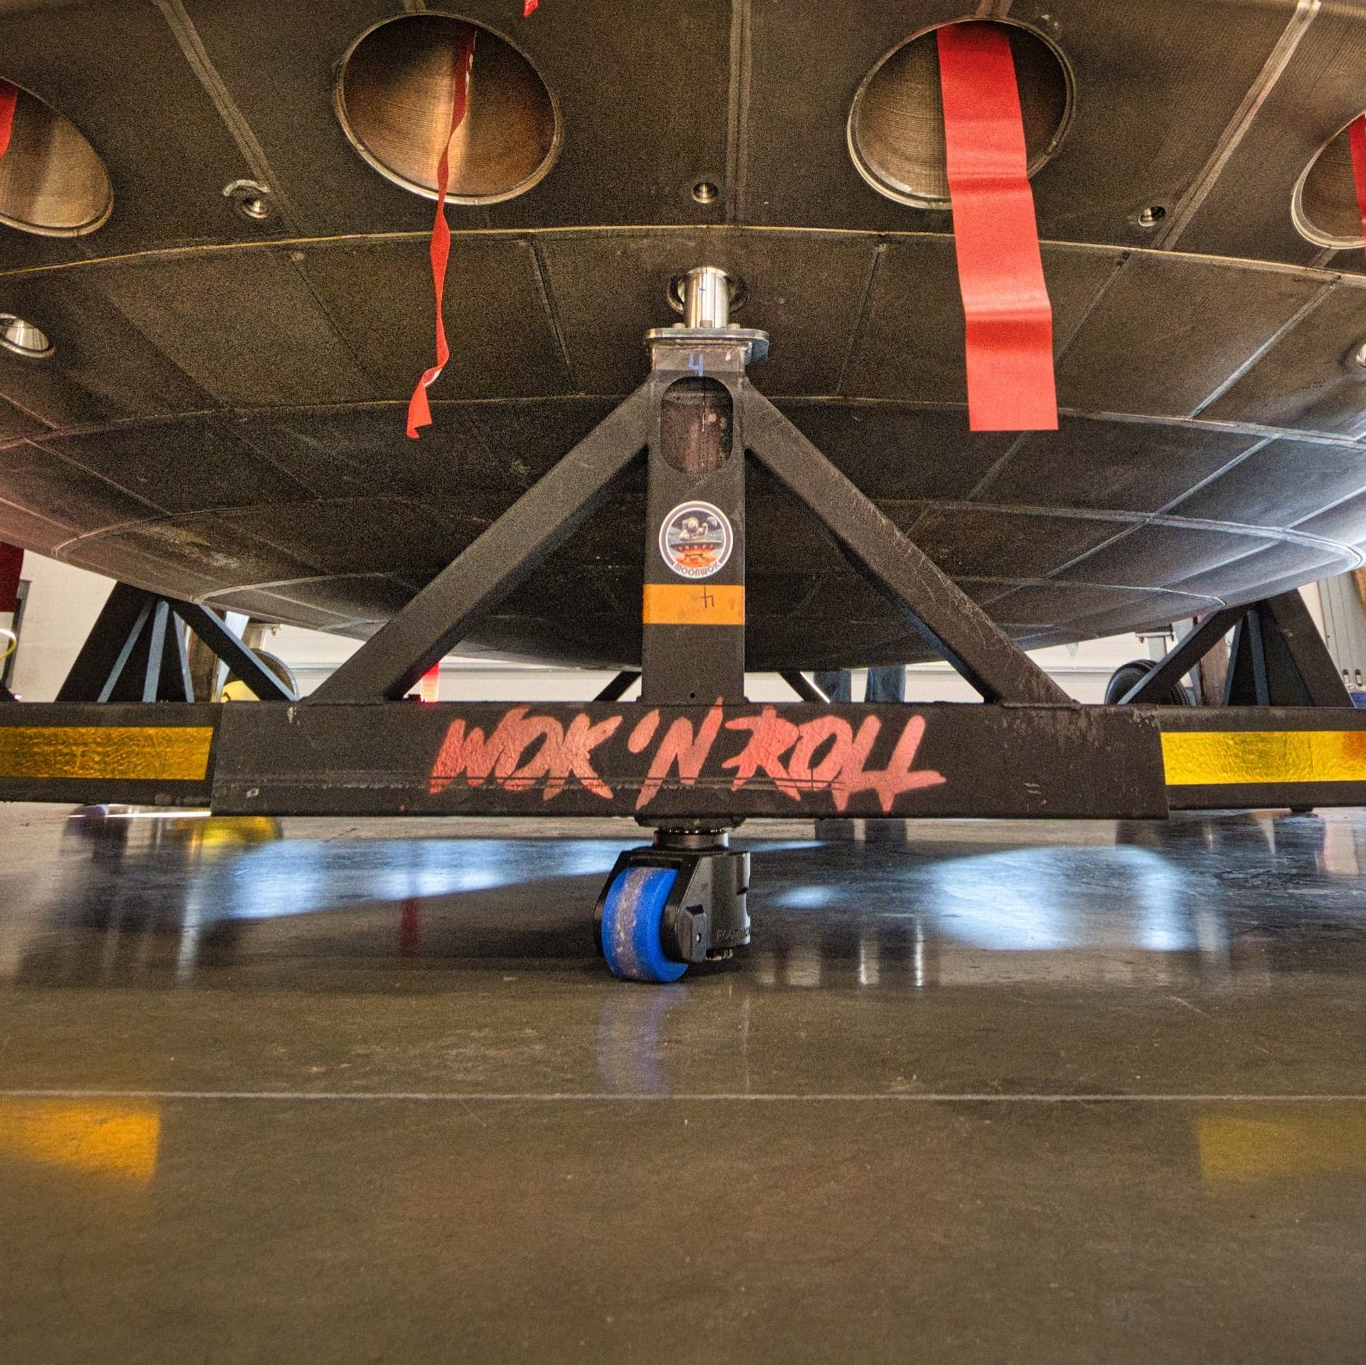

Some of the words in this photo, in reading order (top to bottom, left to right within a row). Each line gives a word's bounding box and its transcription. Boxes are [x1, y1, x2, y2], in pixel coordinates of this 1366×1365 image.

[688, 353, 704, 377] 4
[673, 560, 721, 577] MOONWOK
[429, 704, 623, 800] WOK
[723, 705, 946, 814] ROLL
